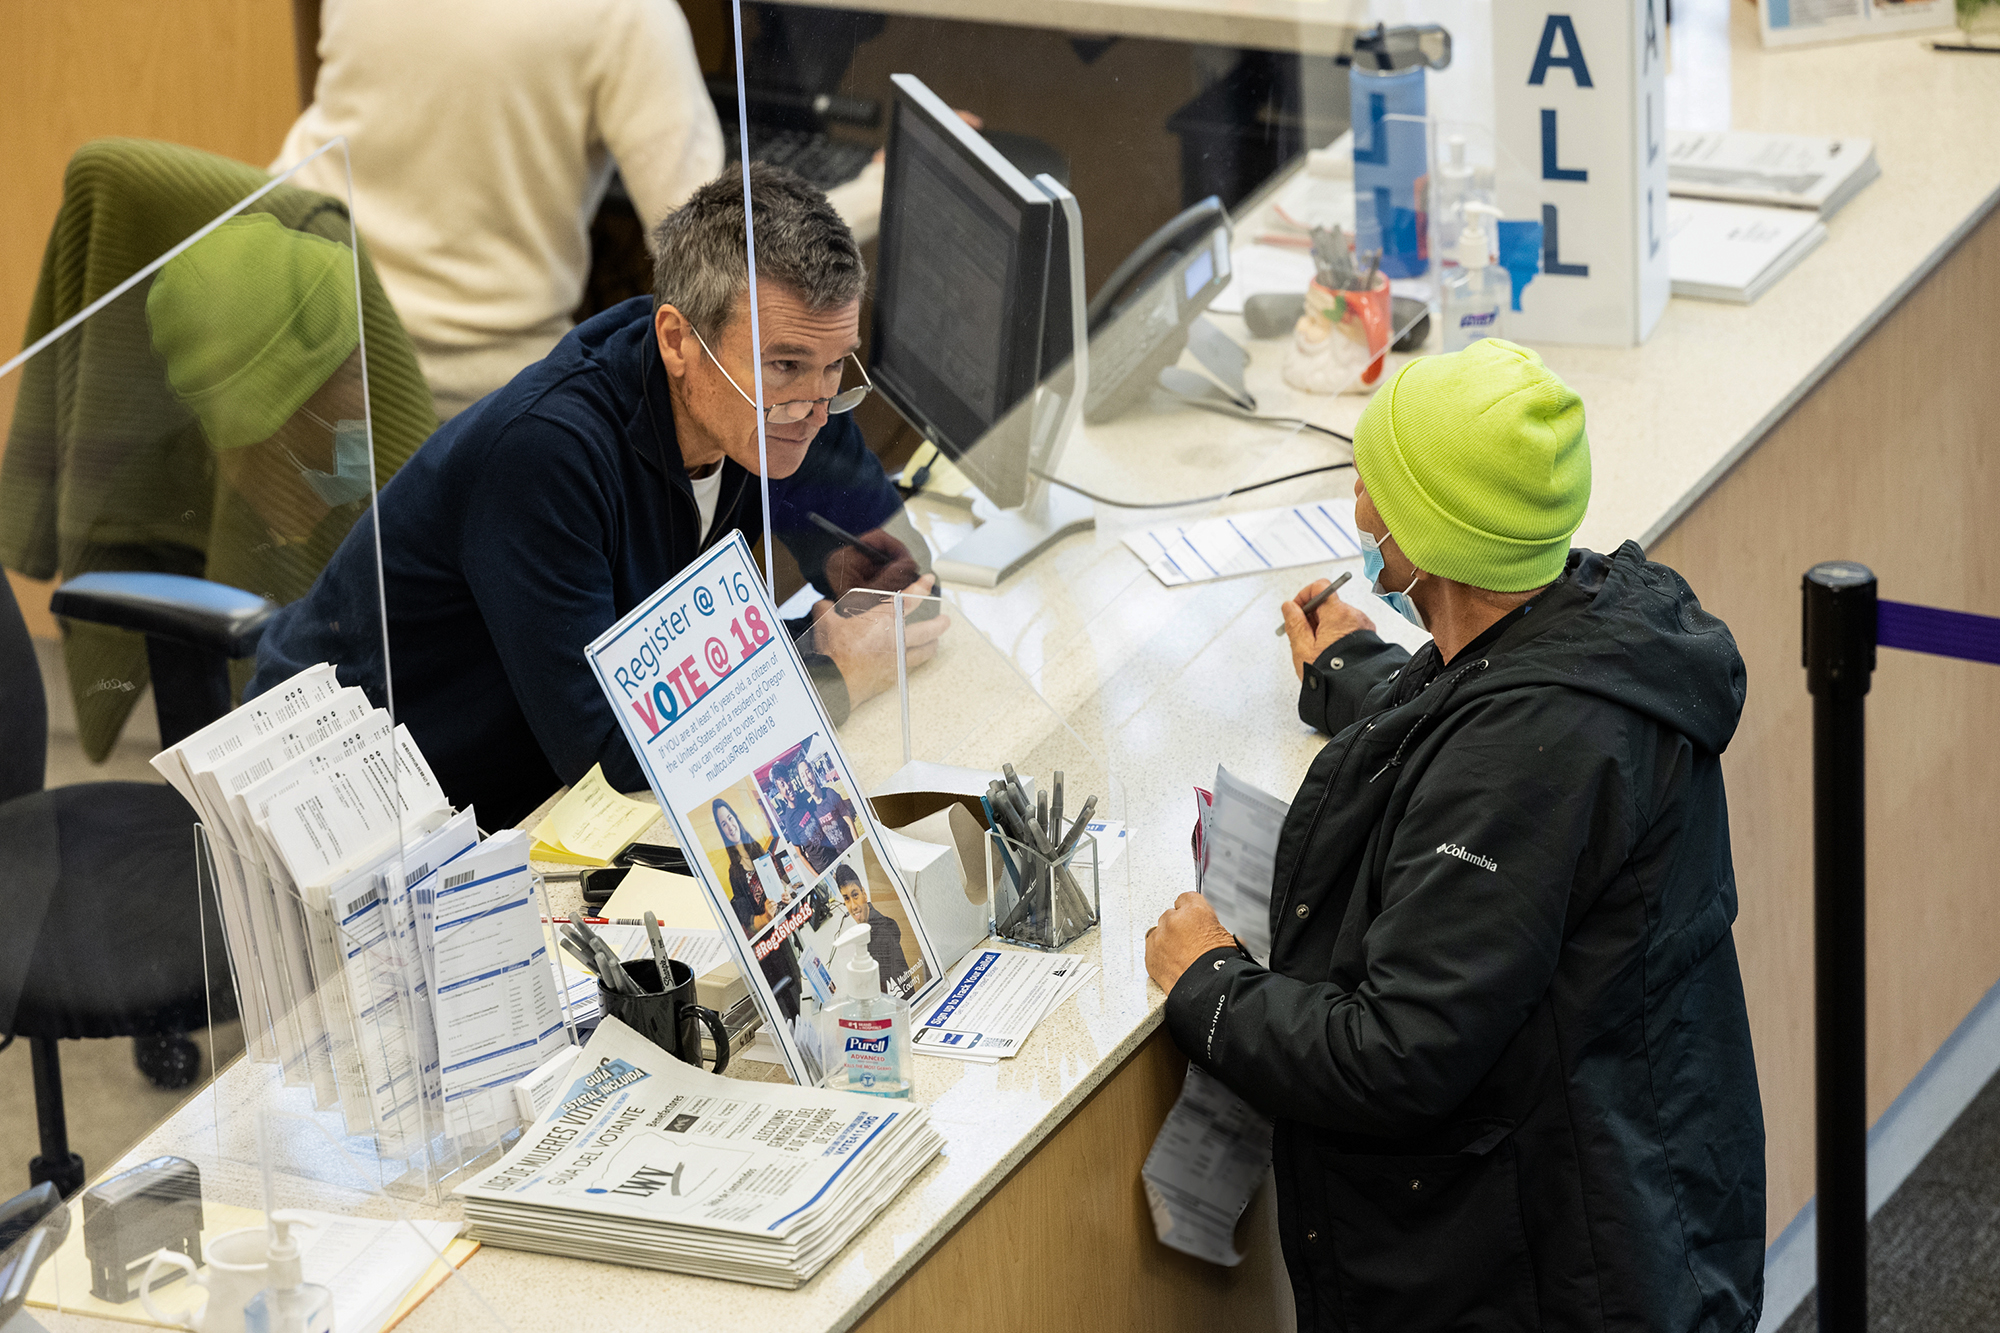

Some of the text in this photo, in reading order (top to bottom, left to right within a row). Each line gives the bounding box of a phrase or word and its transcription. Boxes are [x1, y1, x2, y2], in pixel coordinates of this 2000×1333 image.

[614, 571, 750, 699] Register @ 16
[631, 605, 770, 736] VOTE @ 18
[664, 735, 680, 751] YOU
[680, 728, 691, 741] are
[690, 722, 699, 733] at
[695, 710, 712, 726] least
[710, 702, 720, 714] 16
[718, 691, 736, 710] years
[736, 680, 749, 696] old,
[746, 676, 753, 686] a
[751, 662, 770, 681] citizen
[770, 652, 779, 665] of
[666, 761, 678, 774] the
[679, 744, 698, 762] United
[699, 731, 717, 748] States
[716, 719, 728, 735] and
[732, 693, 757, 717] resident
[755, 685, 764, 699] of
[761, 669, 786, 692] Oregon
[688, 693, 779, 778] you can register to vote TODAY!
[705, 715, 776, 783] multco.us/Reg16Vote18
[1444, 843, 1498, 872] Columbia
[755, 902, 813, 961] #Reg16Vote18
[897, 957, 924, 986] Multnomah
[902, 974, 920, 993] County
[930, 1012, 948, 1025] Sign
[943, 1004, 956, 1013] up
[952, 984, 973, 999] Track
[963, 971, 982, 984] Your
[974, 954, 996, 972] Ballot!
[850, 1037, 886, 1052] Purell
[850, 1053, 886, 1063] ADVANCED
[561, 1068, 646, 1113] ESTATAL INCLUIDA
[585, 1068, 613, 1087] GUÍA
[645, 1095, 684, 1128] Benefactores
[752, 1108, 793, 1141] ELECCIONES
[767, 1107, 816, 1147] GENERALES DEL
[795, 1107, 837, 1139] NOVIEMBRE
[516, 1126, 578, 1168] MUJERES
[547, 1168, 585, 1186] GUÍA
[573, 1151, 603, 1169] DEL
[591, 1106, 645, 1148] VOTANTE
[788, 1139, 808, 1147] DE
[812, 1121, 845, 1144] DE 2022
[833, 1115, 879, 1155] VOTE411.ORG
[479, 1175, 522, 1191] LIGA
[502, 1166, 536, 1177] DE
[611, 1164, 674, 1198] LWV
